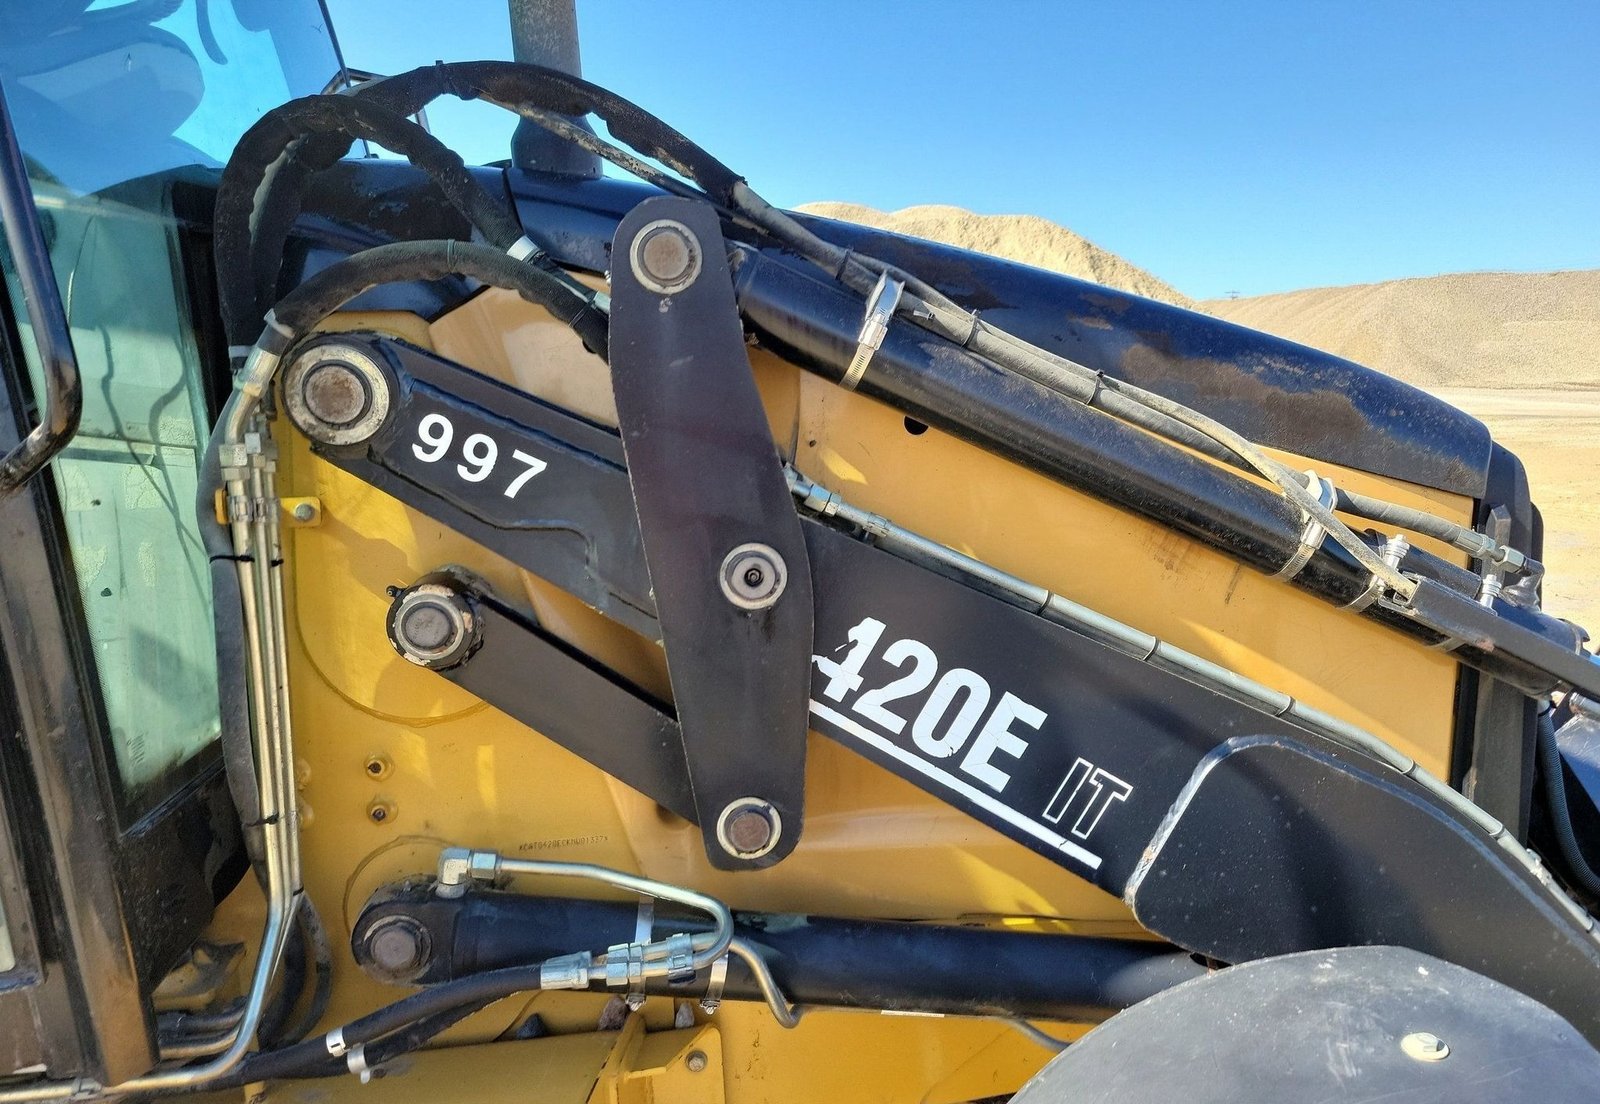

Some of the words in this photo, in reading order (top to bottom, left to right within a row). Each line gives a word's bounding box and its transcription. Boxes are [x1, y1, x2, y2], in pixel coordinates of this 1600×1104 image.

[412, 413, 548, 499] 997
[812, 616, 1048, 794] 420E
[1042, 757, 1134, 839] IT
